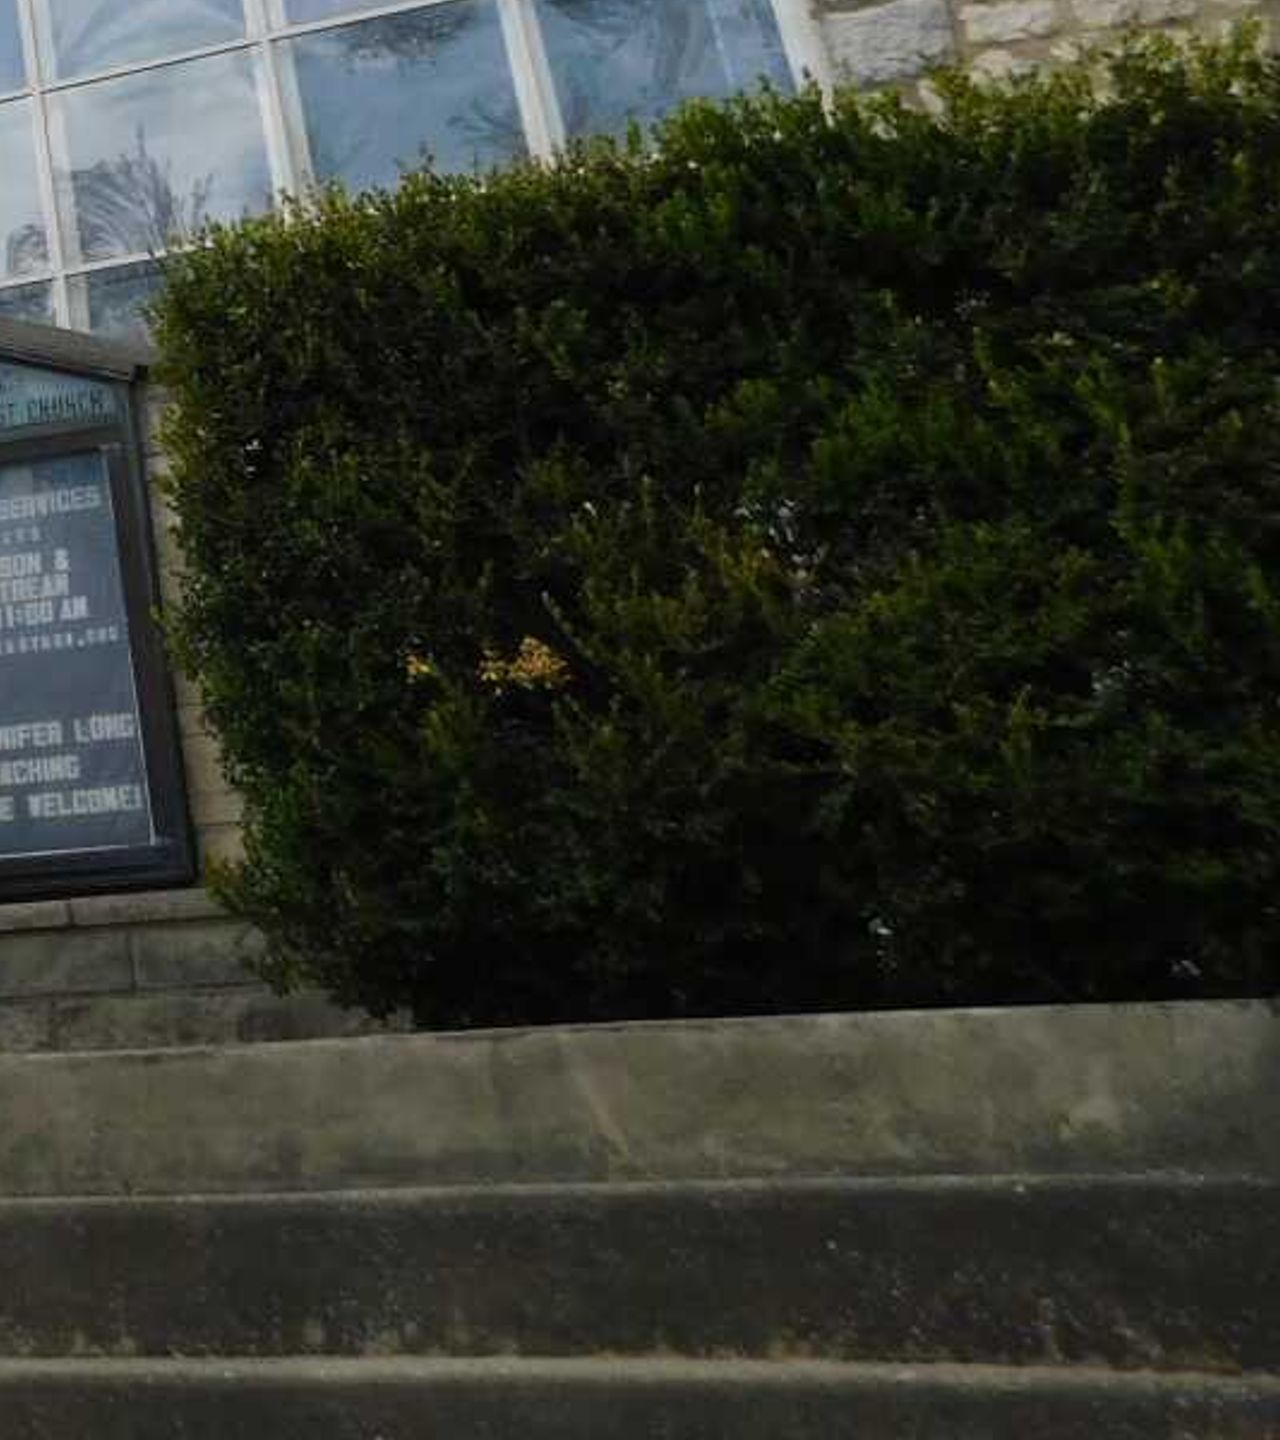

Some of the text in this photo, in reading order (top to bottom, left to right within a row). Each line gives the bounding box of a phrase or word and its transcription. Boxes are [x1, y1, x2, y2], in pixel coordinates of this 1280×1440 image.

[54, 549, 71, 571] &
[60, 596, 89, 621] AM
[74, 712, 135, 743] LONG
[28, 784, 143, 819] WELCOME!
